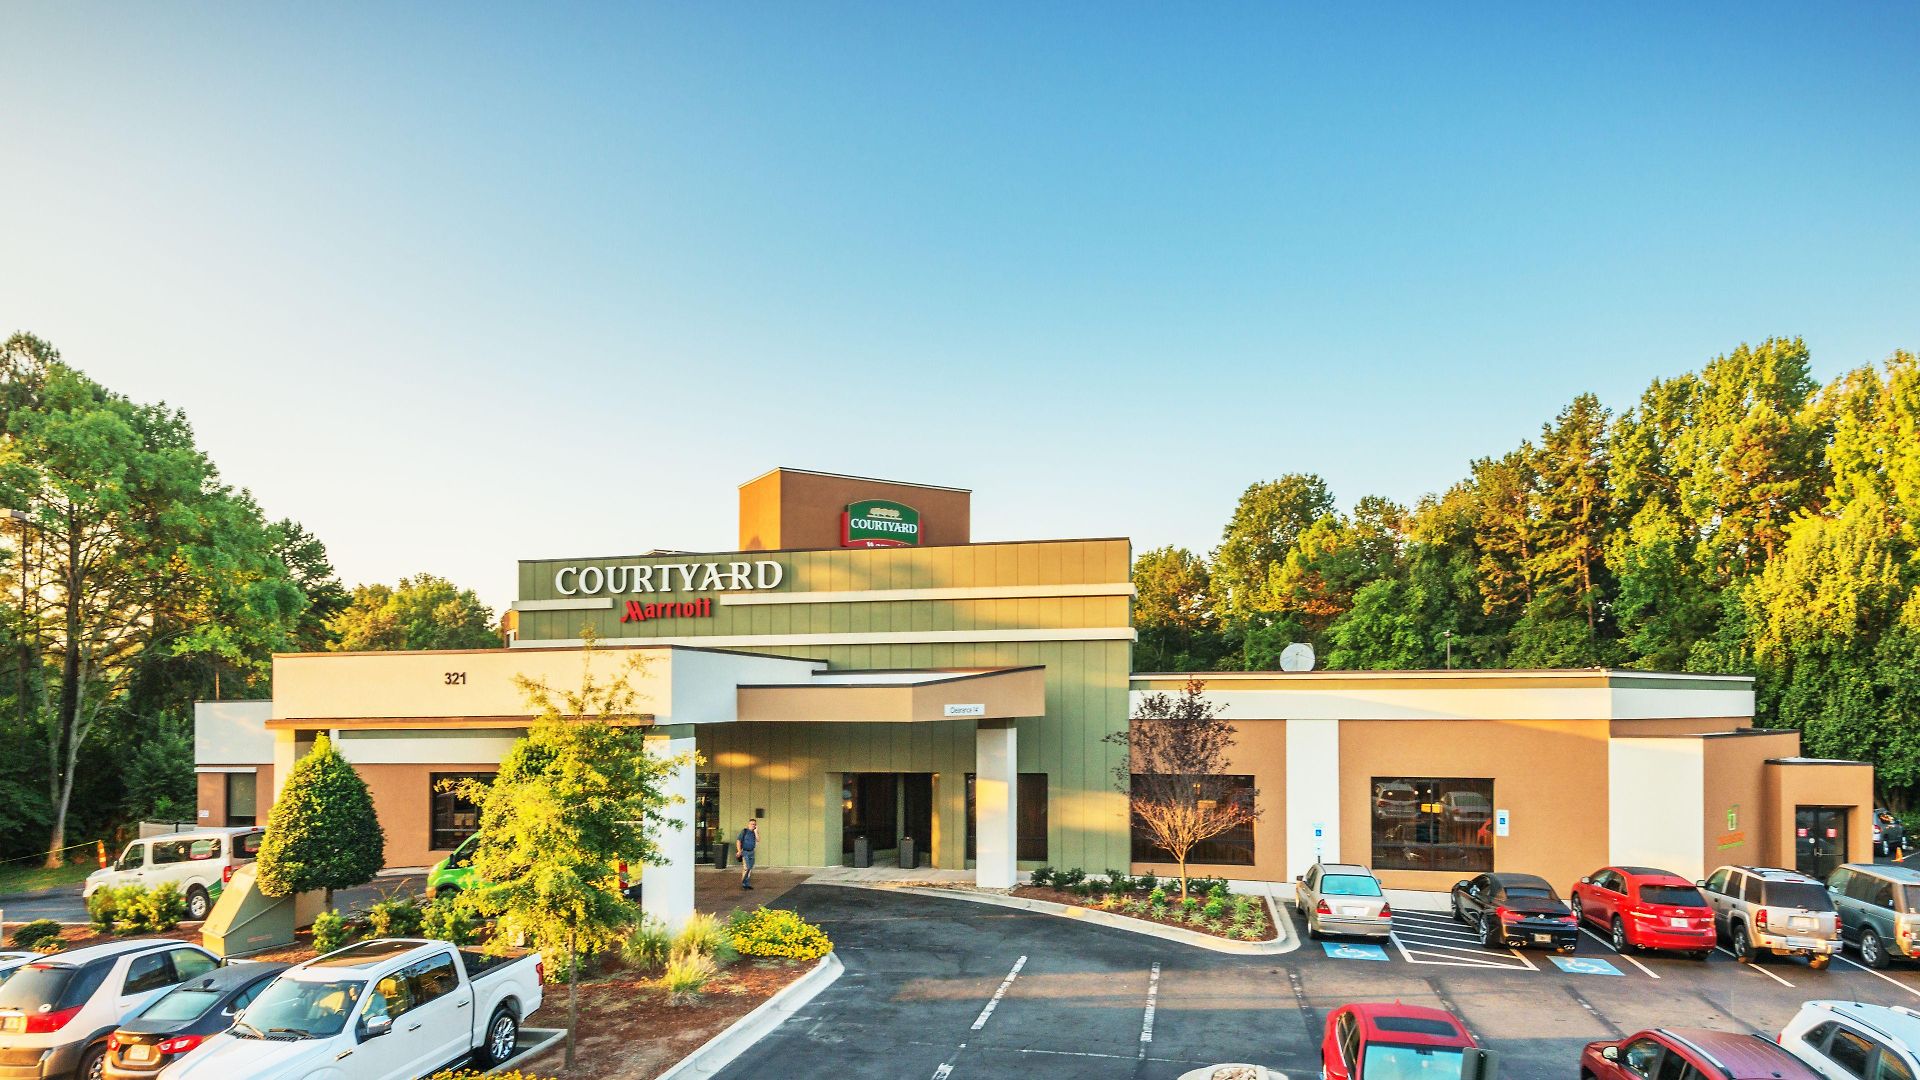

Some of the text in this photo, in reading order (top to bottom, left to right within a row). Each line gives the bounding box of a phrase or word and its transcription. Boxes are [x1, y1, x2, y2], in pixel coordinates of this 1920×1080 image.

[850, 518, 918, 534] COURTYARD
[555, 560, 783, 595] COURTYARD
[619, 597, 712, 623] Marriott
[444, 671, 466, 685] 321
